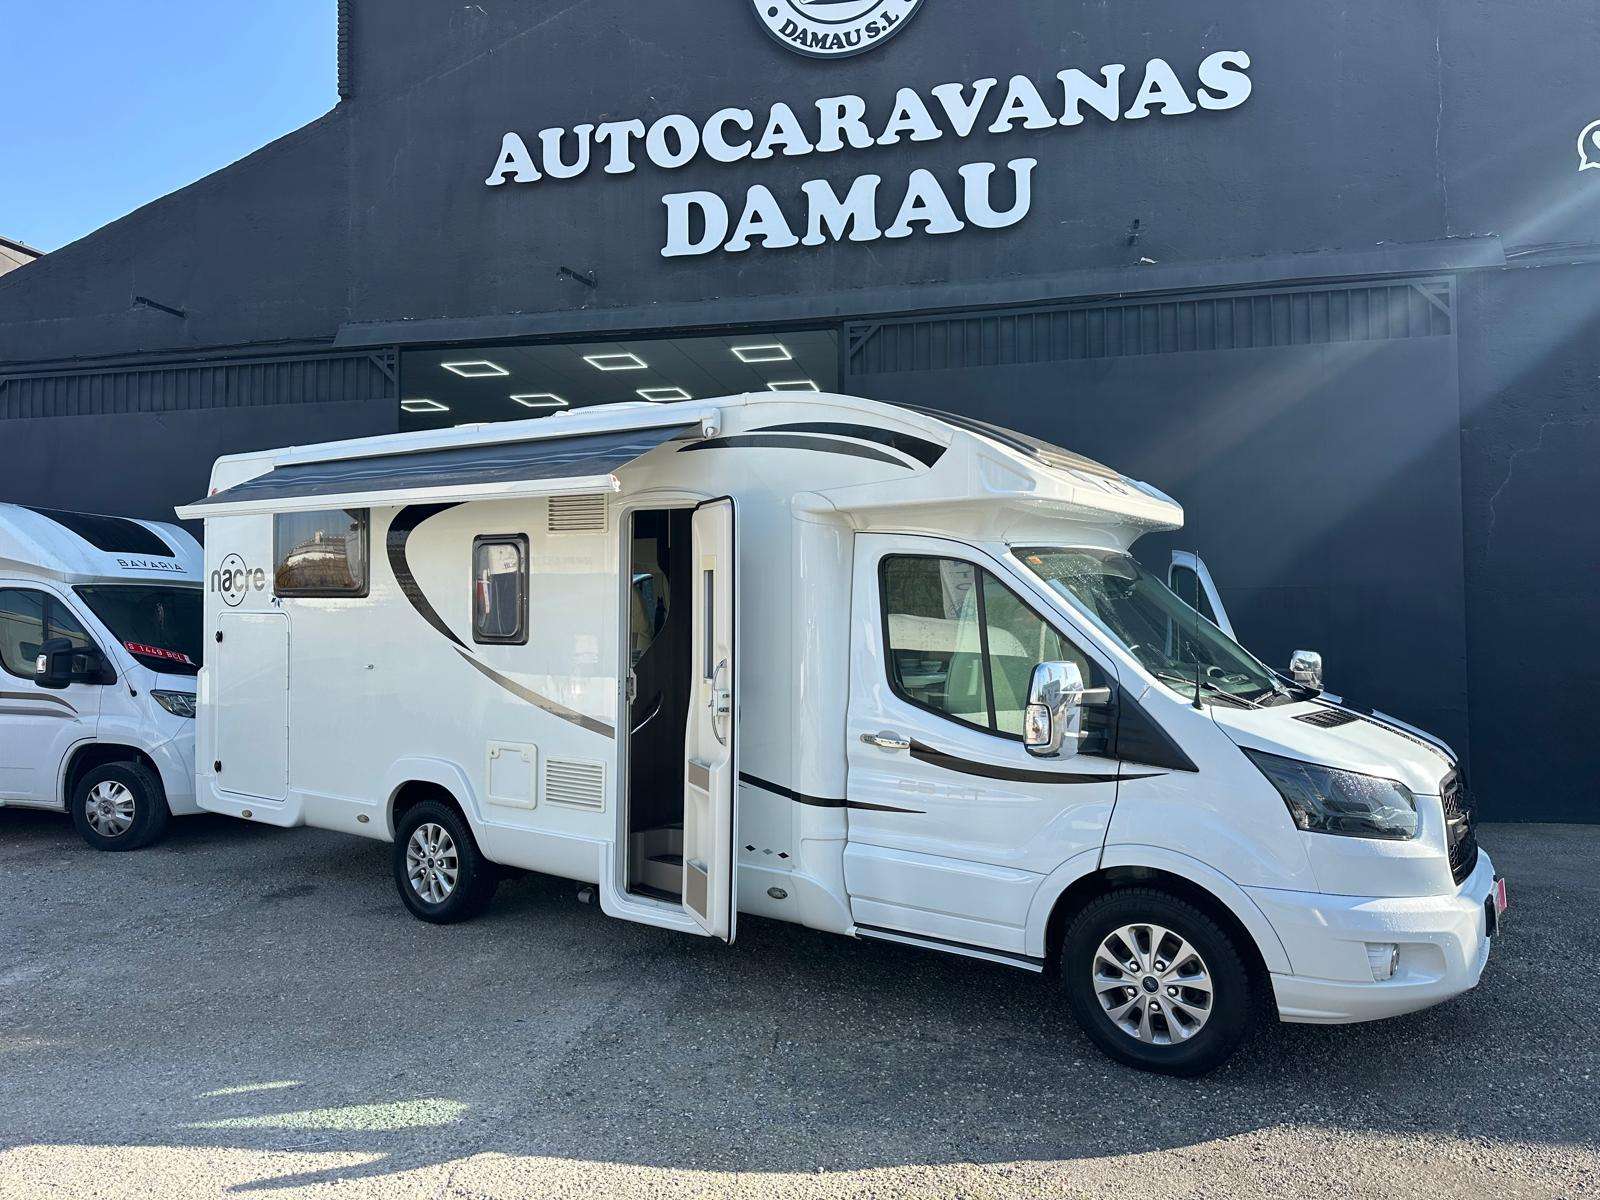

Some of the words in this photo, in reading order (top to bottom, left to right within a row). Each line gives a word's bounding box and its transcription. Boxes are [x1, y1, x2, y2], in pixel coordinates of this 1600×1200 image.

[778, 18, 863, 50] DAMAU
[485, 50, 1252, 186] AUTOCARAVANAS
[660, 157, 1038, 257] DAMAU
[117, 558, 184, 571] BAVARIA
[211, 567, 266, 592] nacre
